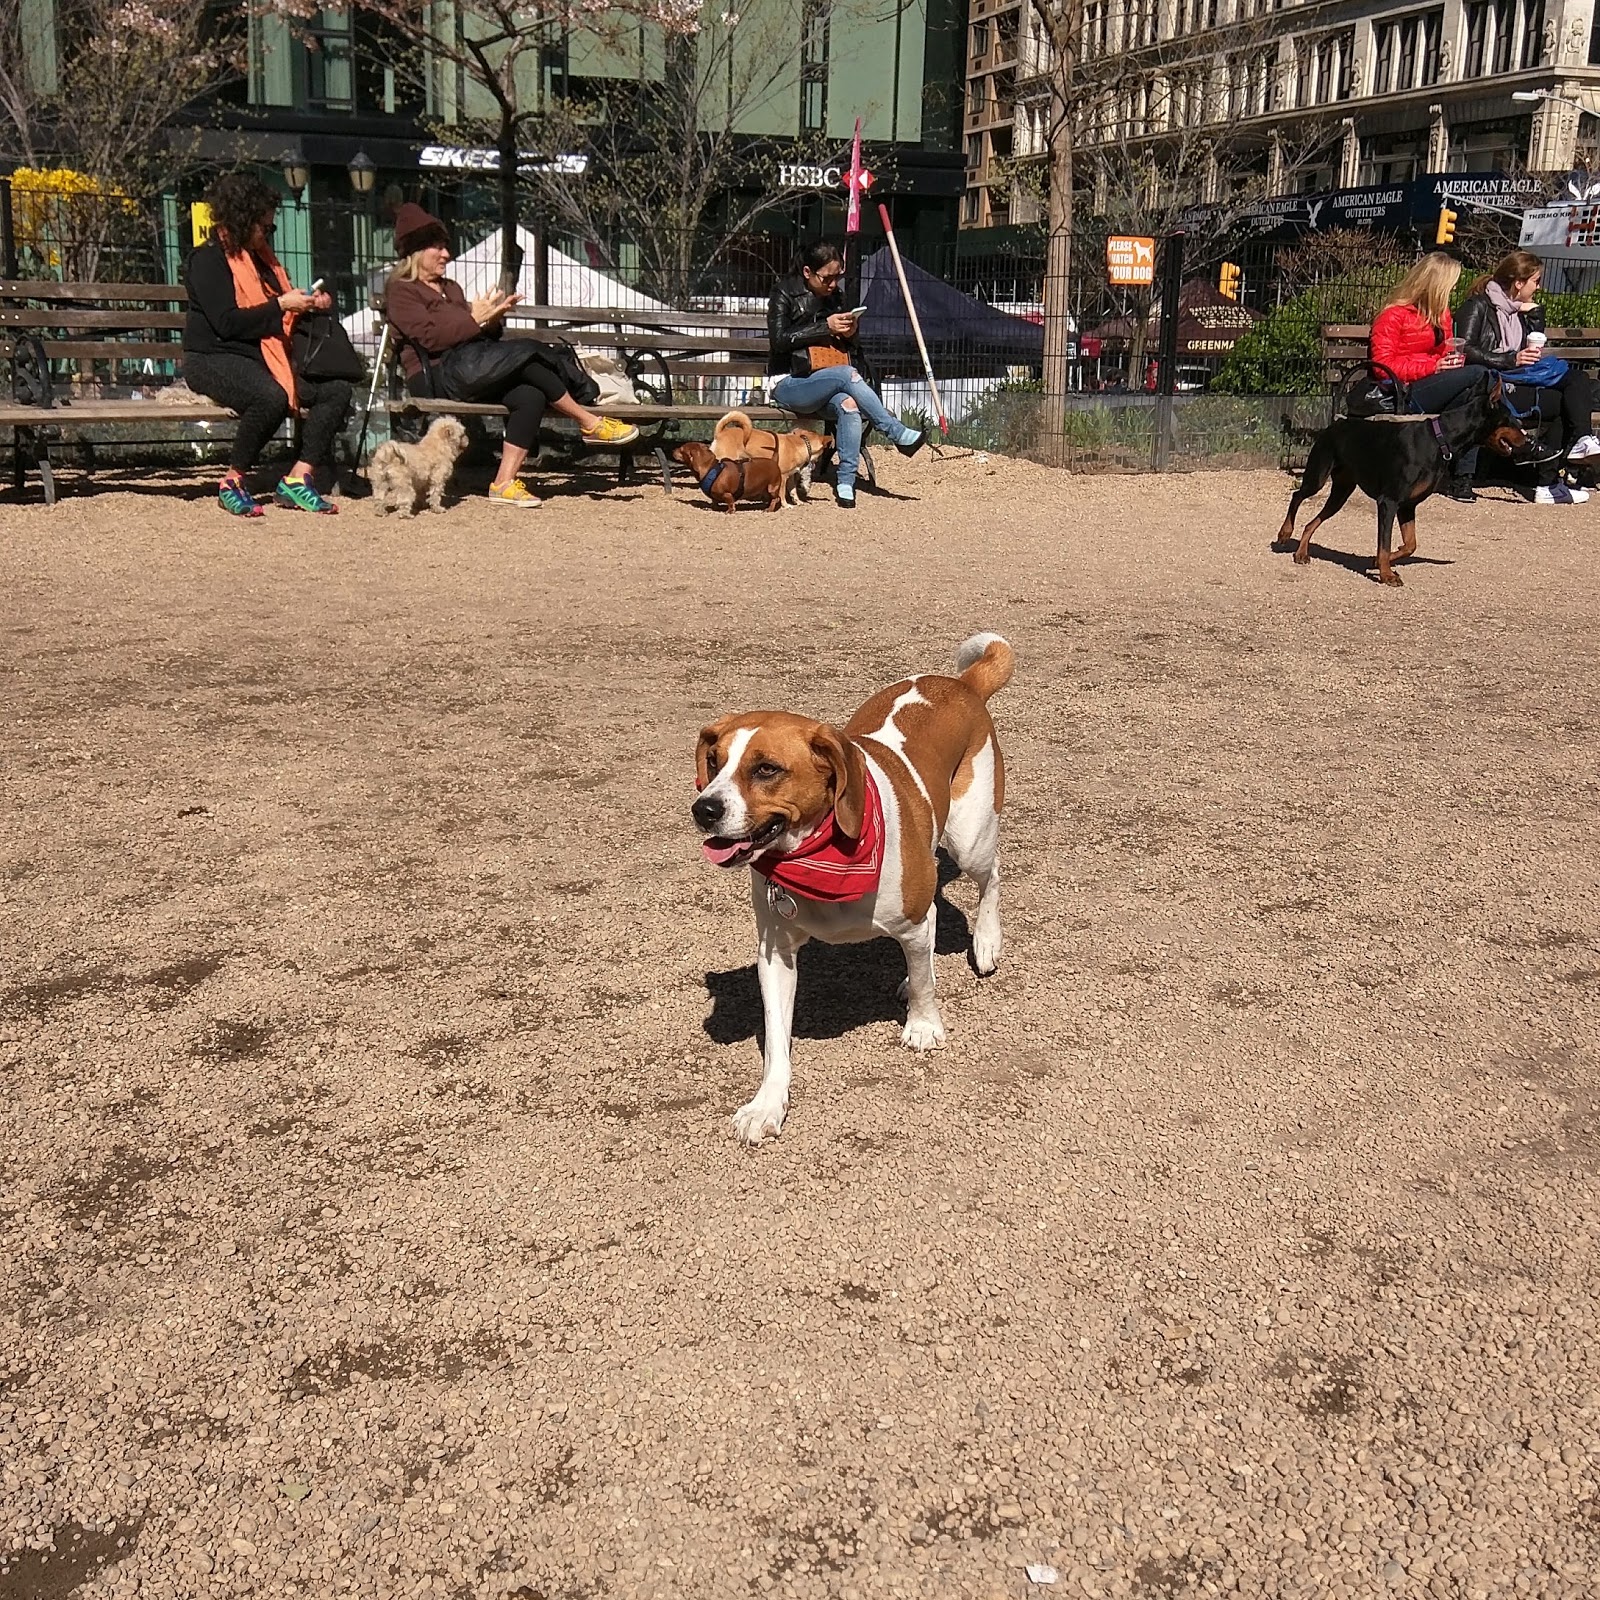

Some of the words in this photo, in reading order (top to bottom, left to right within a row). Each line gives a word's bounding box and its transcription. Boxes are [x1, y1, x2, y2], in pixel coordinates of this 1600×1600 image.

[419, 146, 588, 173] SKECRS
[778, 165, 841, 188] HSBC
[1433, 180, 1498, 194] AMERICAN
[1500, 179, 1542, 193] EAGLE
[1332, 193, 1375, 209] AMERICAN
[1375, 190, 1403, 205] EAGLE
[1454, 194, 1516, 207] OUTFITTERS
[1345, 206, 1386, 219] OUTFITTERS
[1528, 212, 1559, 220] THERMO
[1109, 240, 1133, 252] PLEASE
[1132, 266, 1153, 281] DOG
